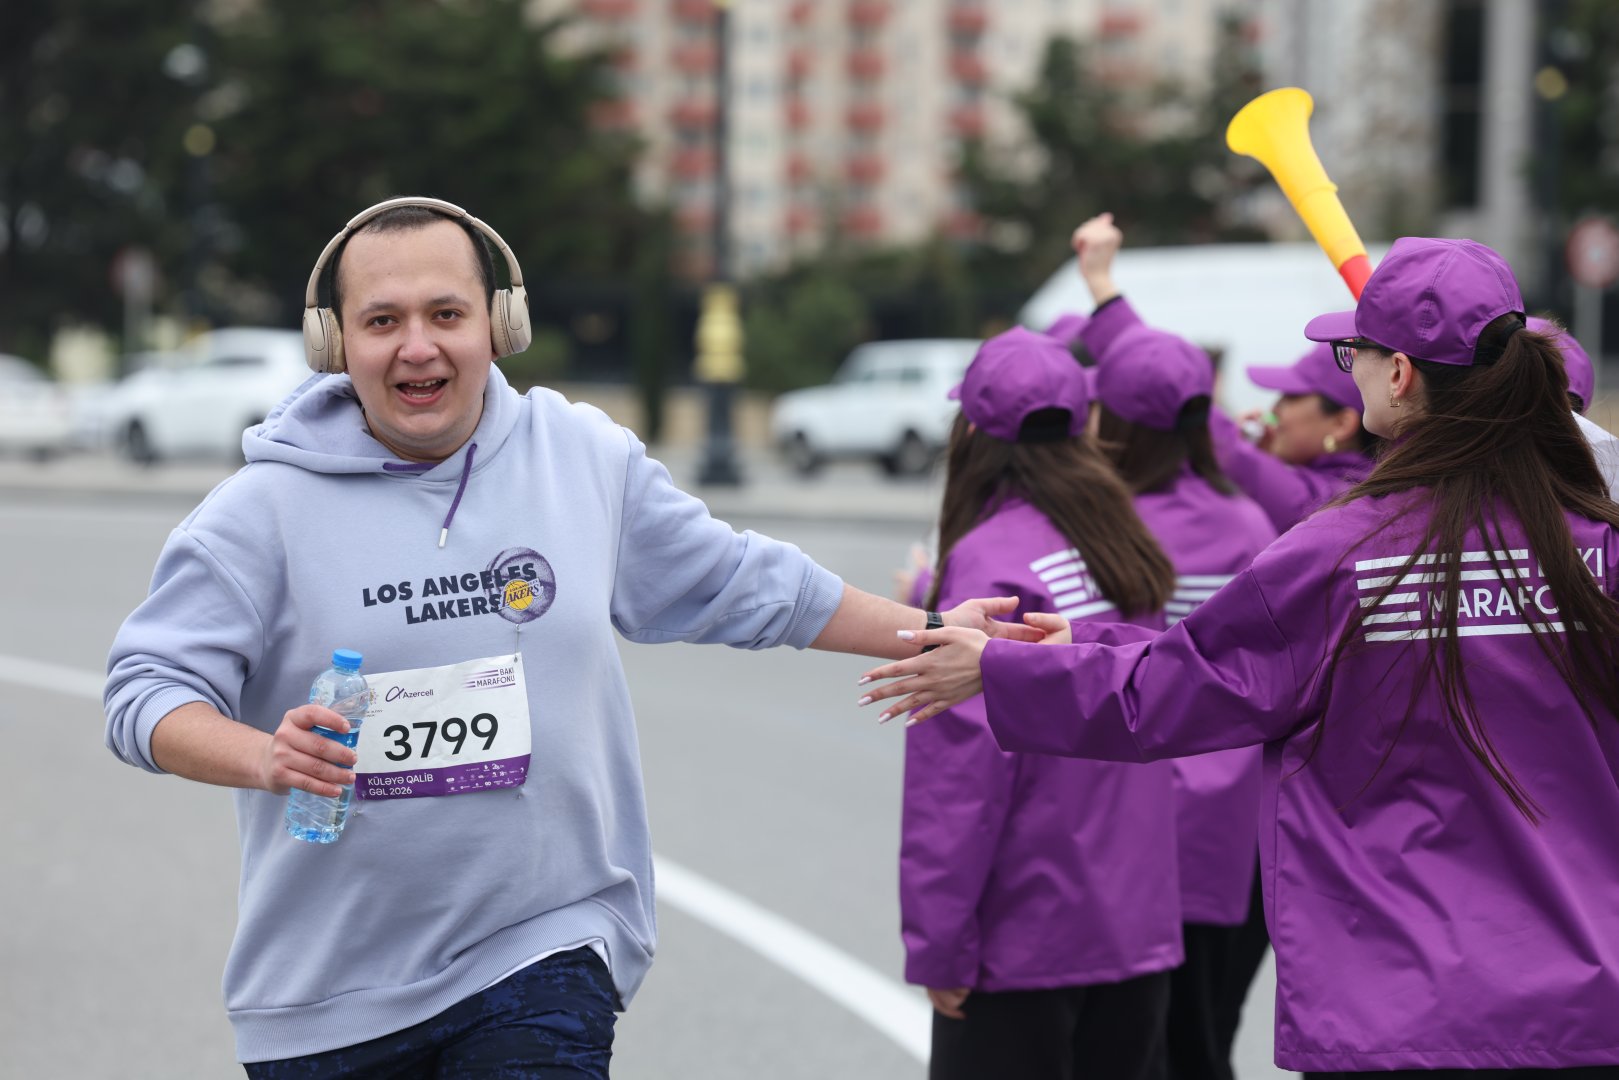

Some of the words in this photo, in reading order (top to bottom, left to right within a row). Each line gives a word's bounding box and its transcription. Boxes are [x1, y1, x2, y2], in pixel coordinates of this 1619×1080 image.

[1538, 548, 1602, 577] KI
[362, 581, 413, 607] LOS
[422, 563, 537, 597] ANGELES
[502, 583, 539, 608] LAKERS
[405, 593, 502, 624] LAKERS
[1427, 584, 1604, 619] MARAFO
[402, 689, 434, 699] Azercell
[476, 675, 515, 687] MARAFONU
[383, 713, 499, 761] 3799
[369, 787, 389, 796] GƏL
[389, 786, 412, 795] 2026
